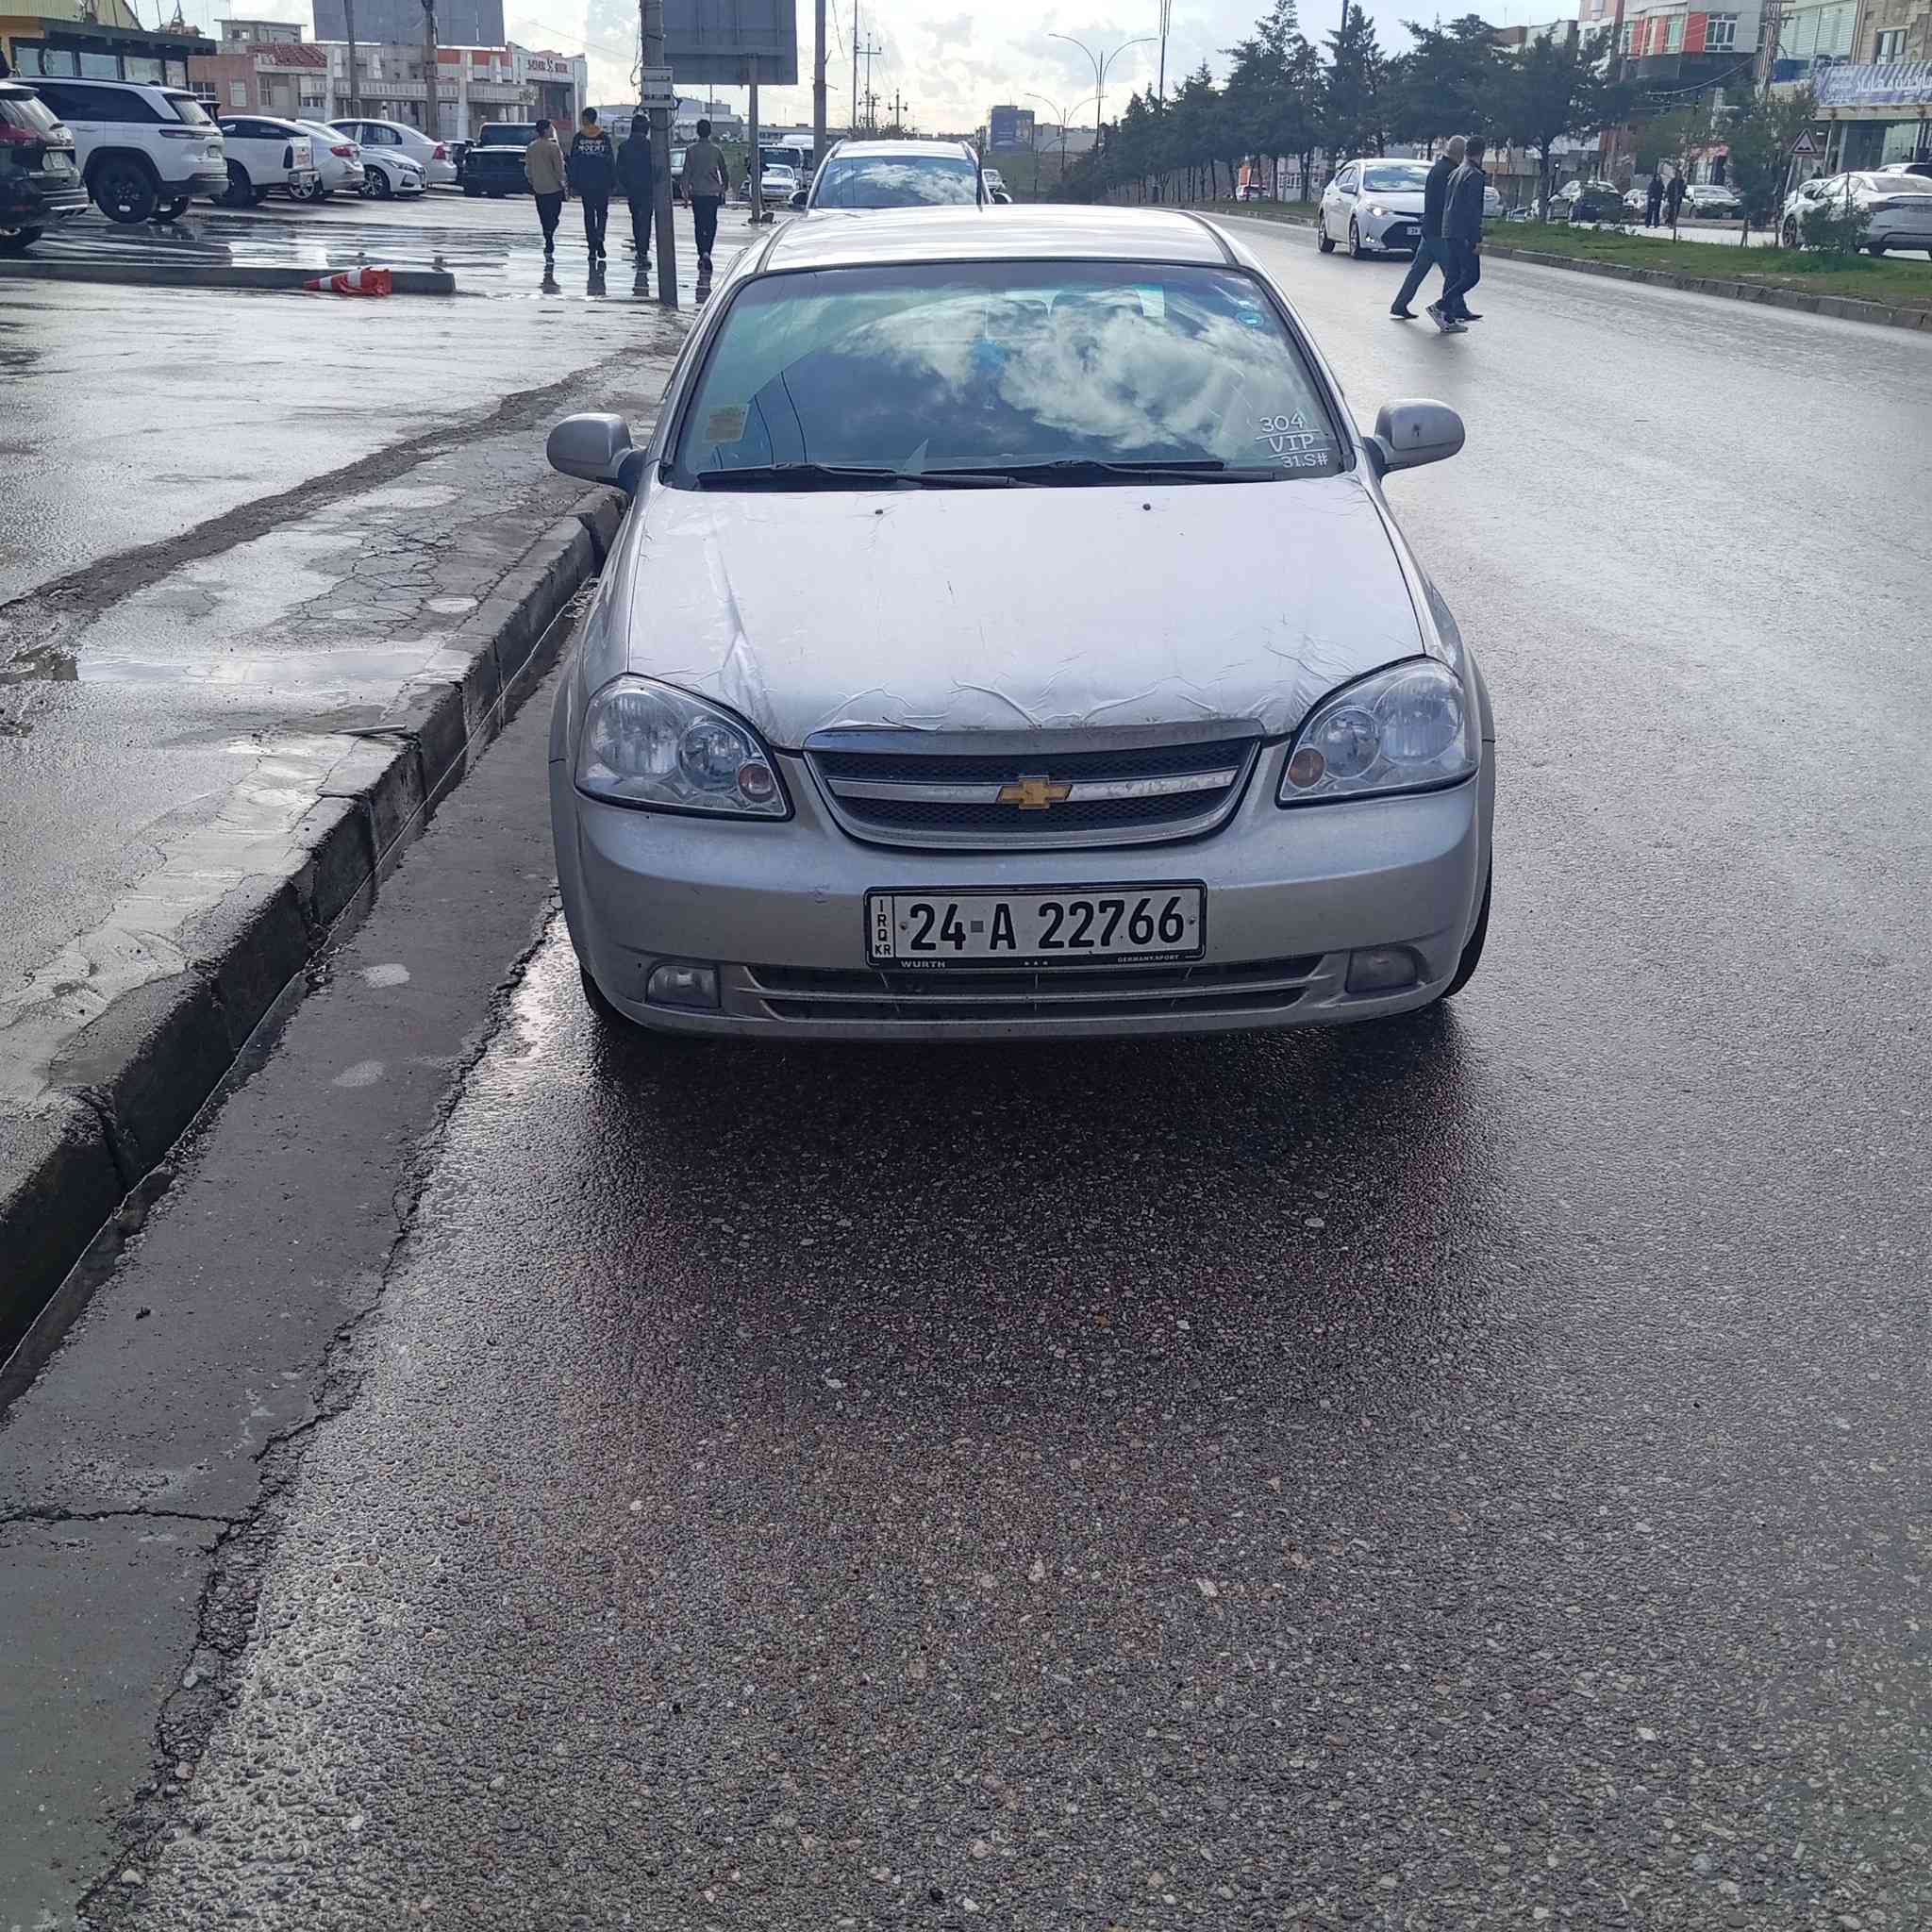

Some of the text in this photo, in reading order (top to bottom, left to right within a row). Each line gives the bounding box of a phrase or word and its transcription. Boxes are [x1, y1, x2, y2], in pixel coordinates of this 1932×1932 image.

[1259, 411, 1306, 432] 304
[1269, 434, 1314, 453] VIP
[909, 896, 1185, 951] 24 A 22766
